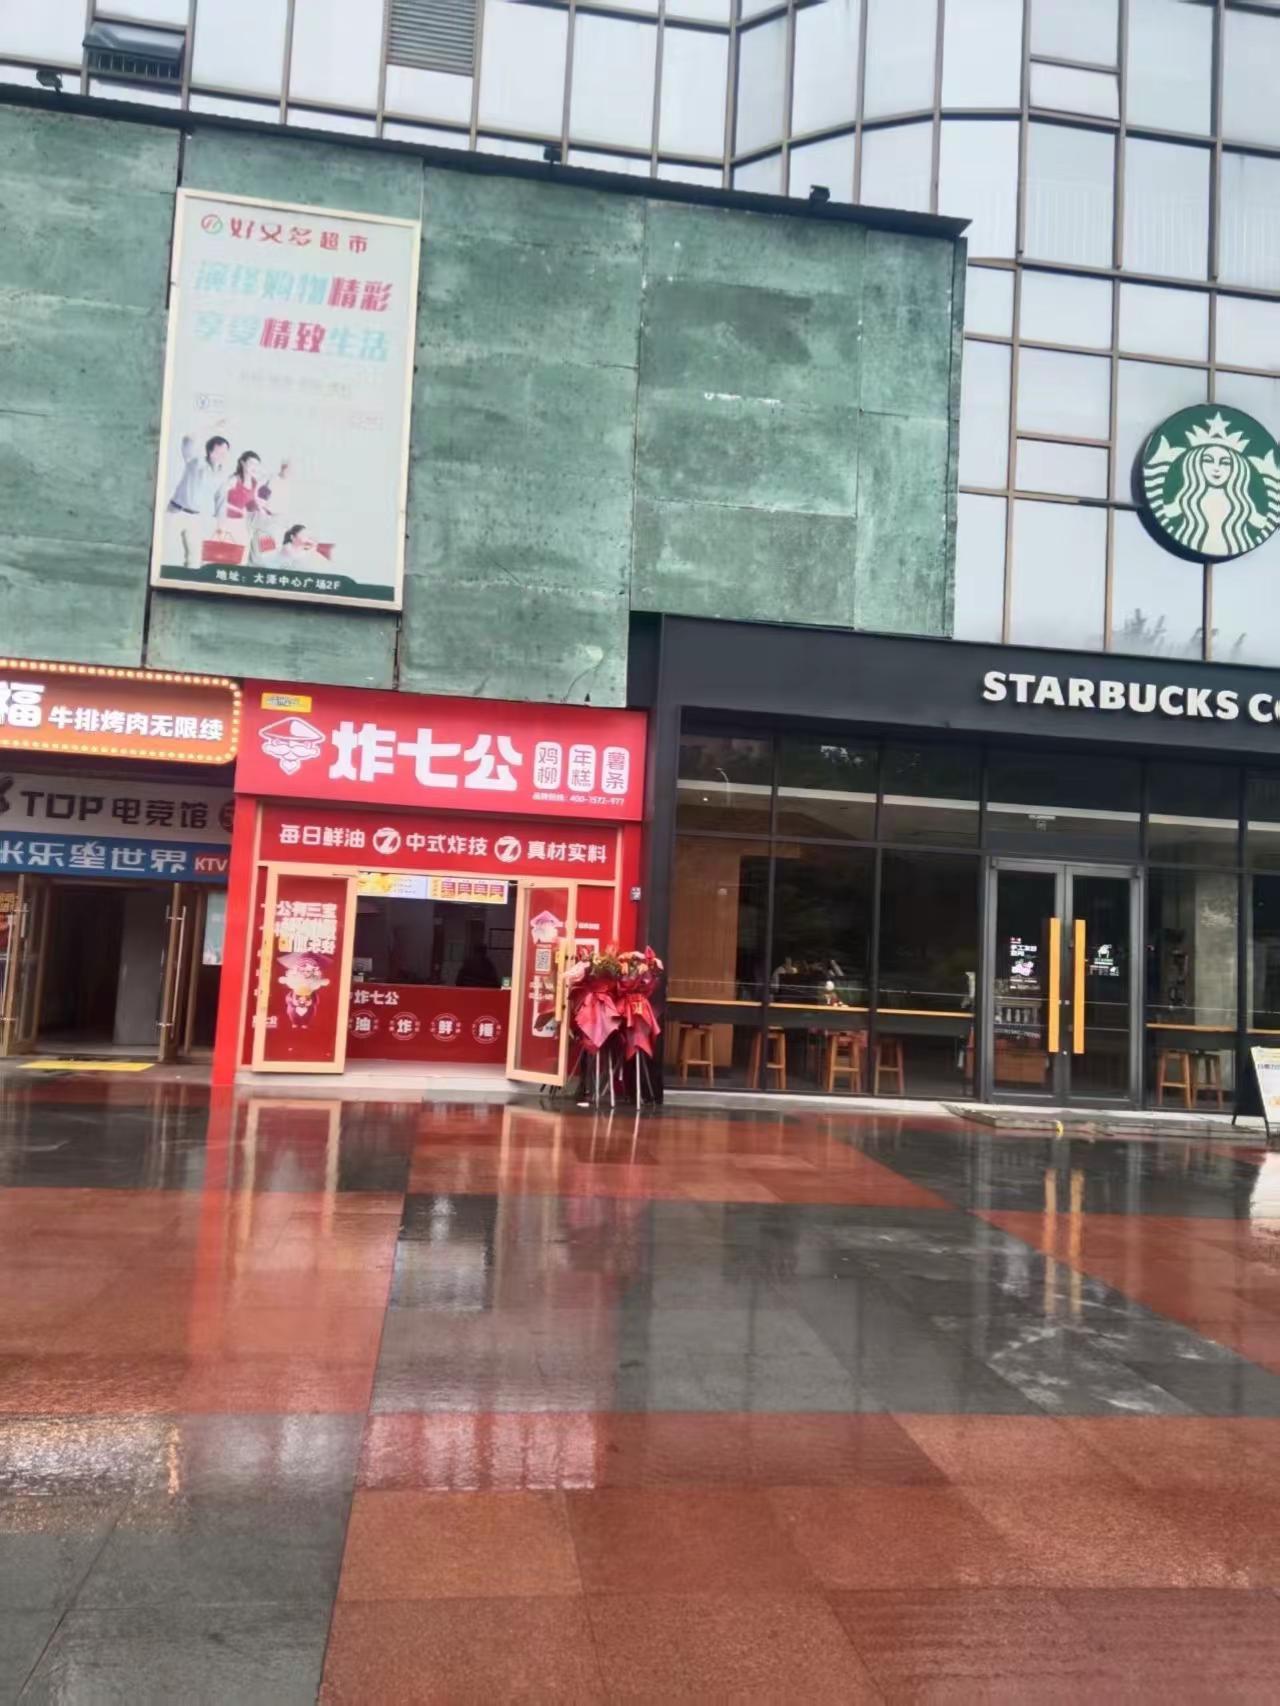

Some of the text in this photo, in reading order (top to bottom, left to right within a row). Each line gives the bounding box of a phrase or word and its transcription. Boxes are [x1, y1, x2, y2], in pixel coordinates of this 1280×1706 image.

[229, 217, 368, 254] 好又多超市
[982, 670, 1240, 720] STARBUCKS
[48, 705, 225, 741] 牛排烤肉无限续
[329, 720, 524, 791] 炸七公
[538, 747, 559, 785] 鸡柳
[572, 749, 593, 788] 年糕
[606, 752, 625, 790] 薯条
[279, 824, 365, 849] 每日鲜油
[405, 832, 488, 857] 中式炸技
[527, 840, 607, 864] 真材实料
[194, 857, 228, 873] KTV
[353, 989, 399, 1006] 炸七公
[397, 1019, 412, 1034] 炸
